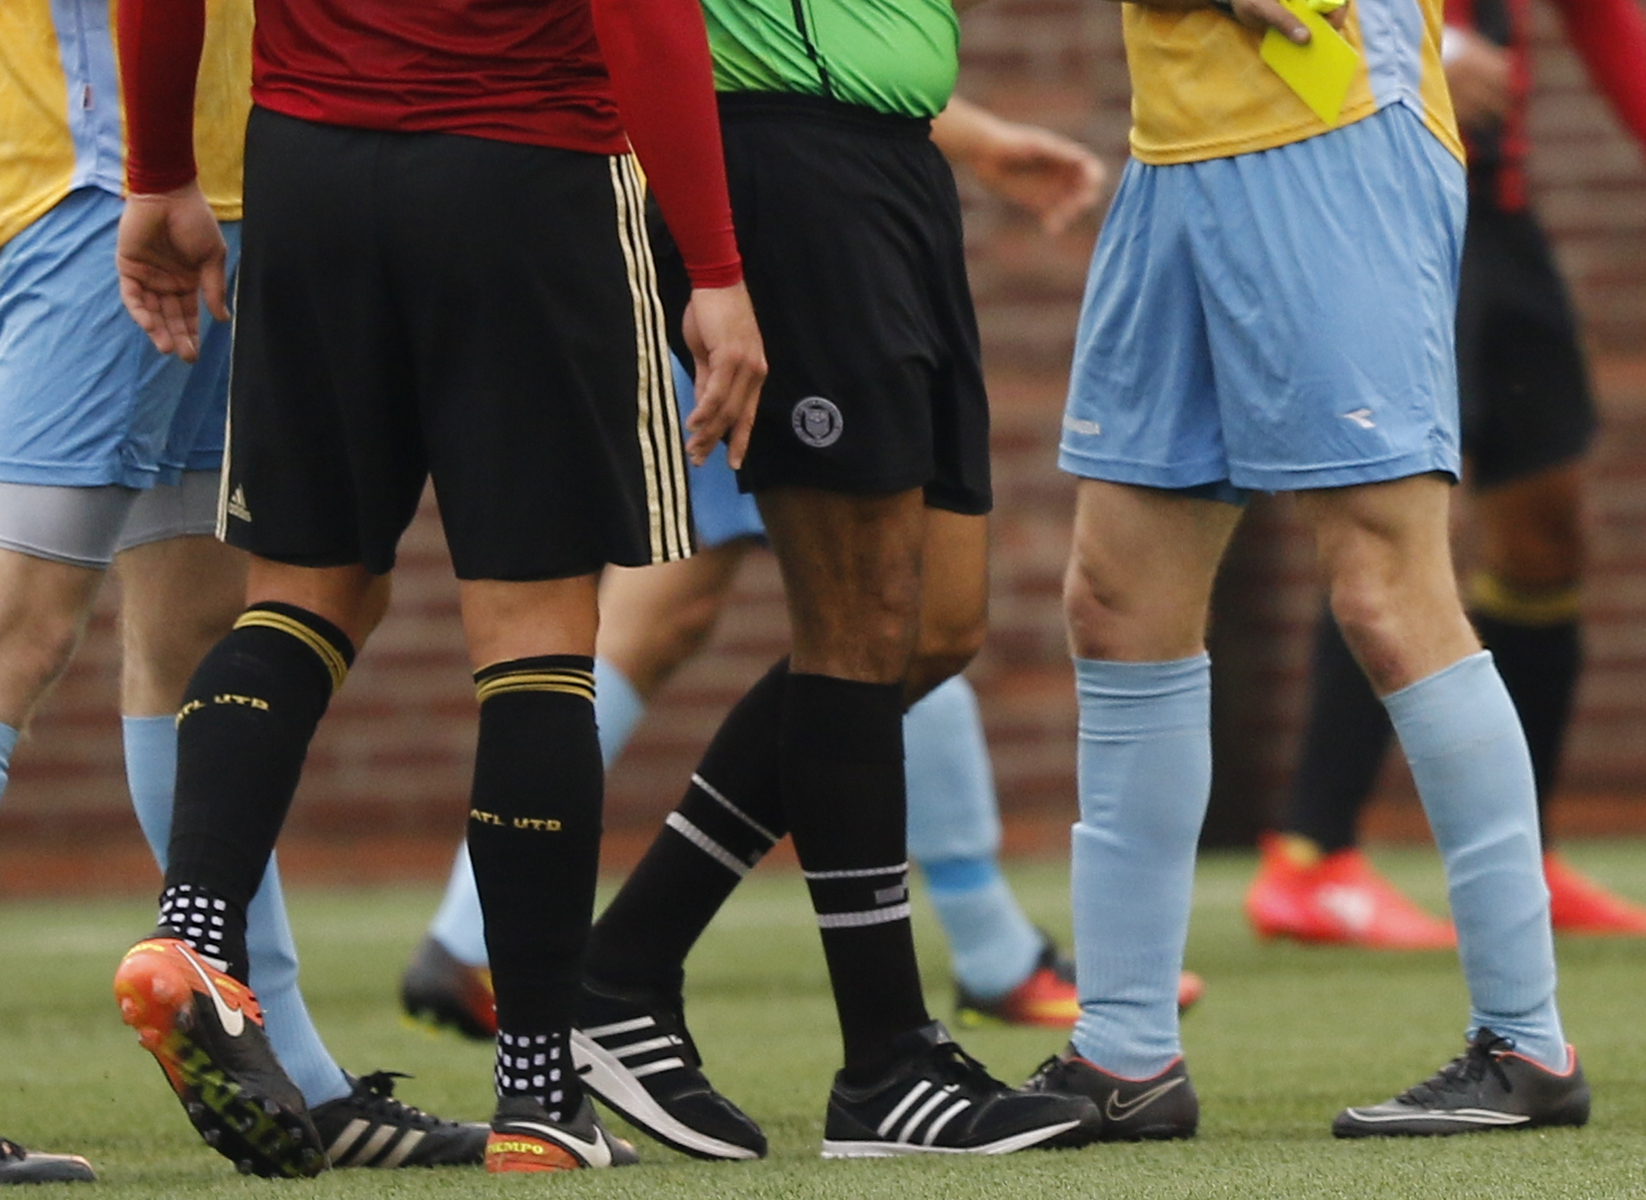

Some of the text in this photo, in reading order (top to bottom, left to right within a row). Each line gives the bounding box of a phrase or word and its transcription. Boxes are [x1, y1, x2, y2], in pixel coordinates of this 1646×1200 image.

[214, 693, 269, 711] UTD
[470, 808, 562, 832] ATL UTD
